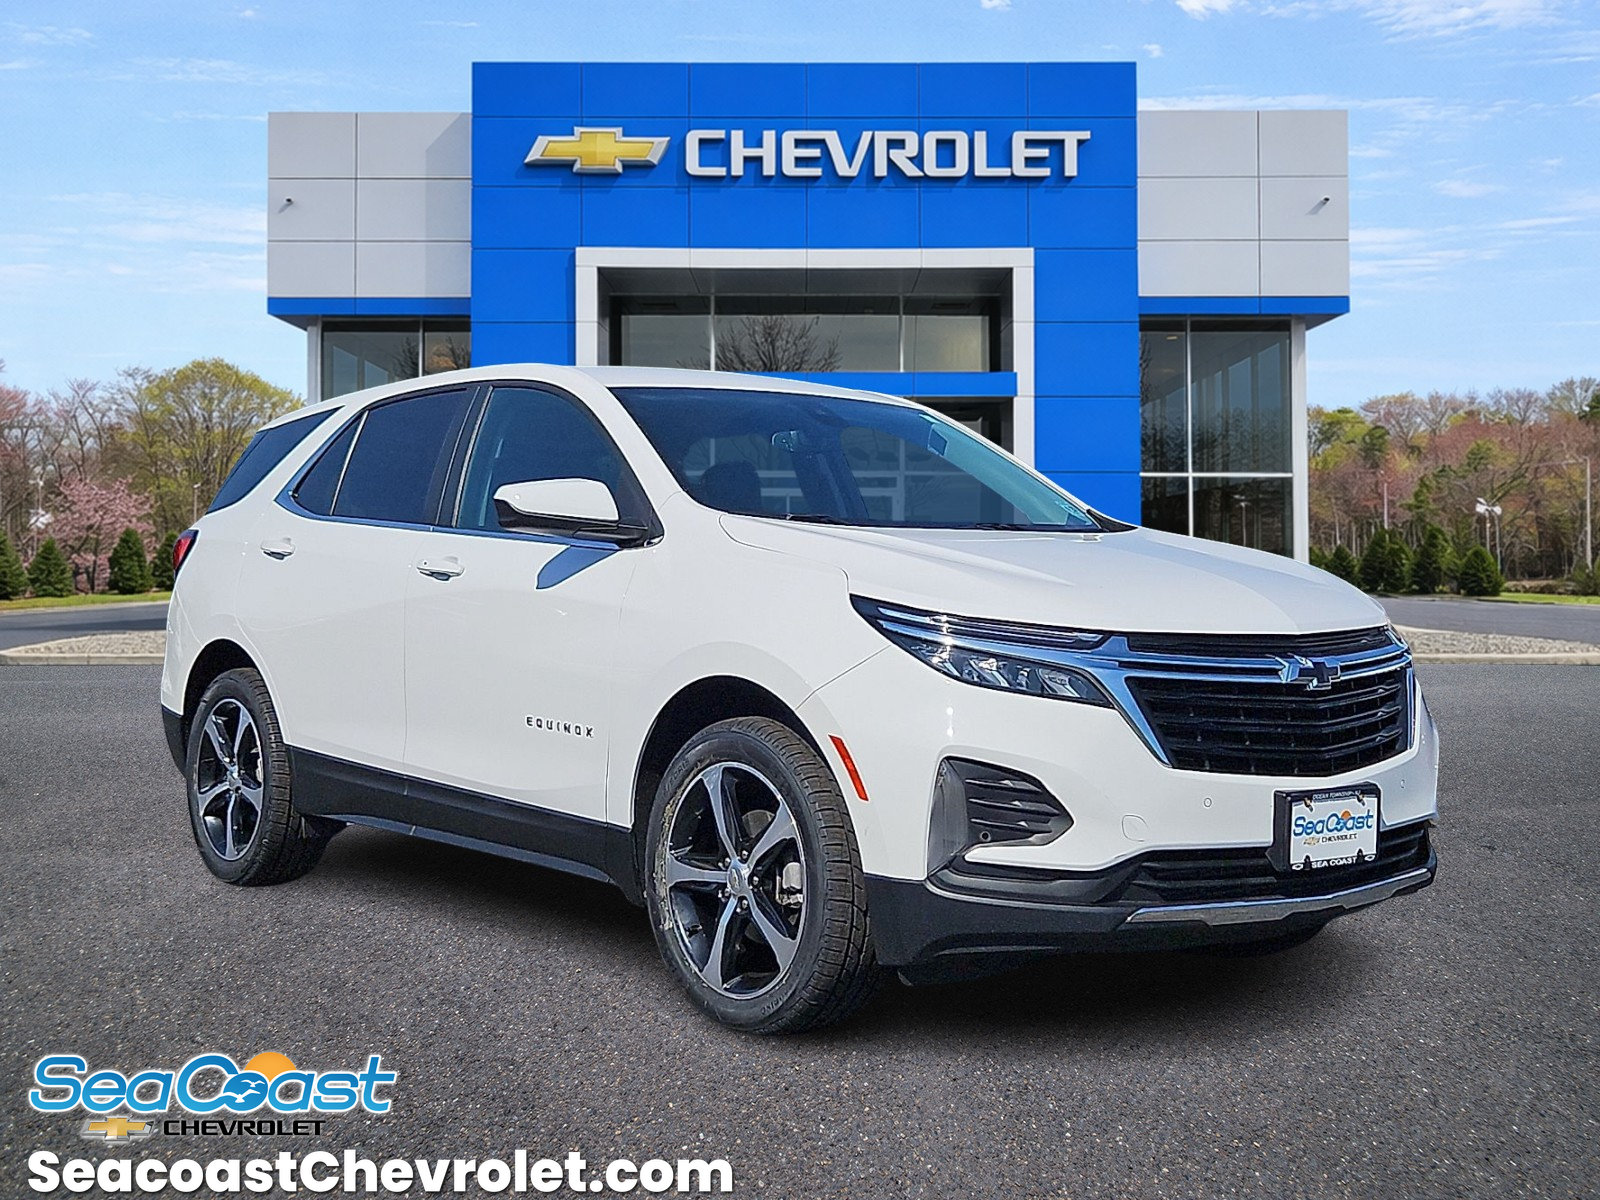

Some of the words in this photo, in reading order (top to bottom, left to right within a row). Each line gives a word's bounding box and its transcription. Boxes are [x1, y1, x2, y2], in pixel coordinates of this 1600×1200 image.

[685, 129, 1091, 178] CHEVROLET
[526, 716, 594, 739] EQUINOX
[1311, 860, 1328, 869] SEA
[1329, 856, 1357, 866] COAST
